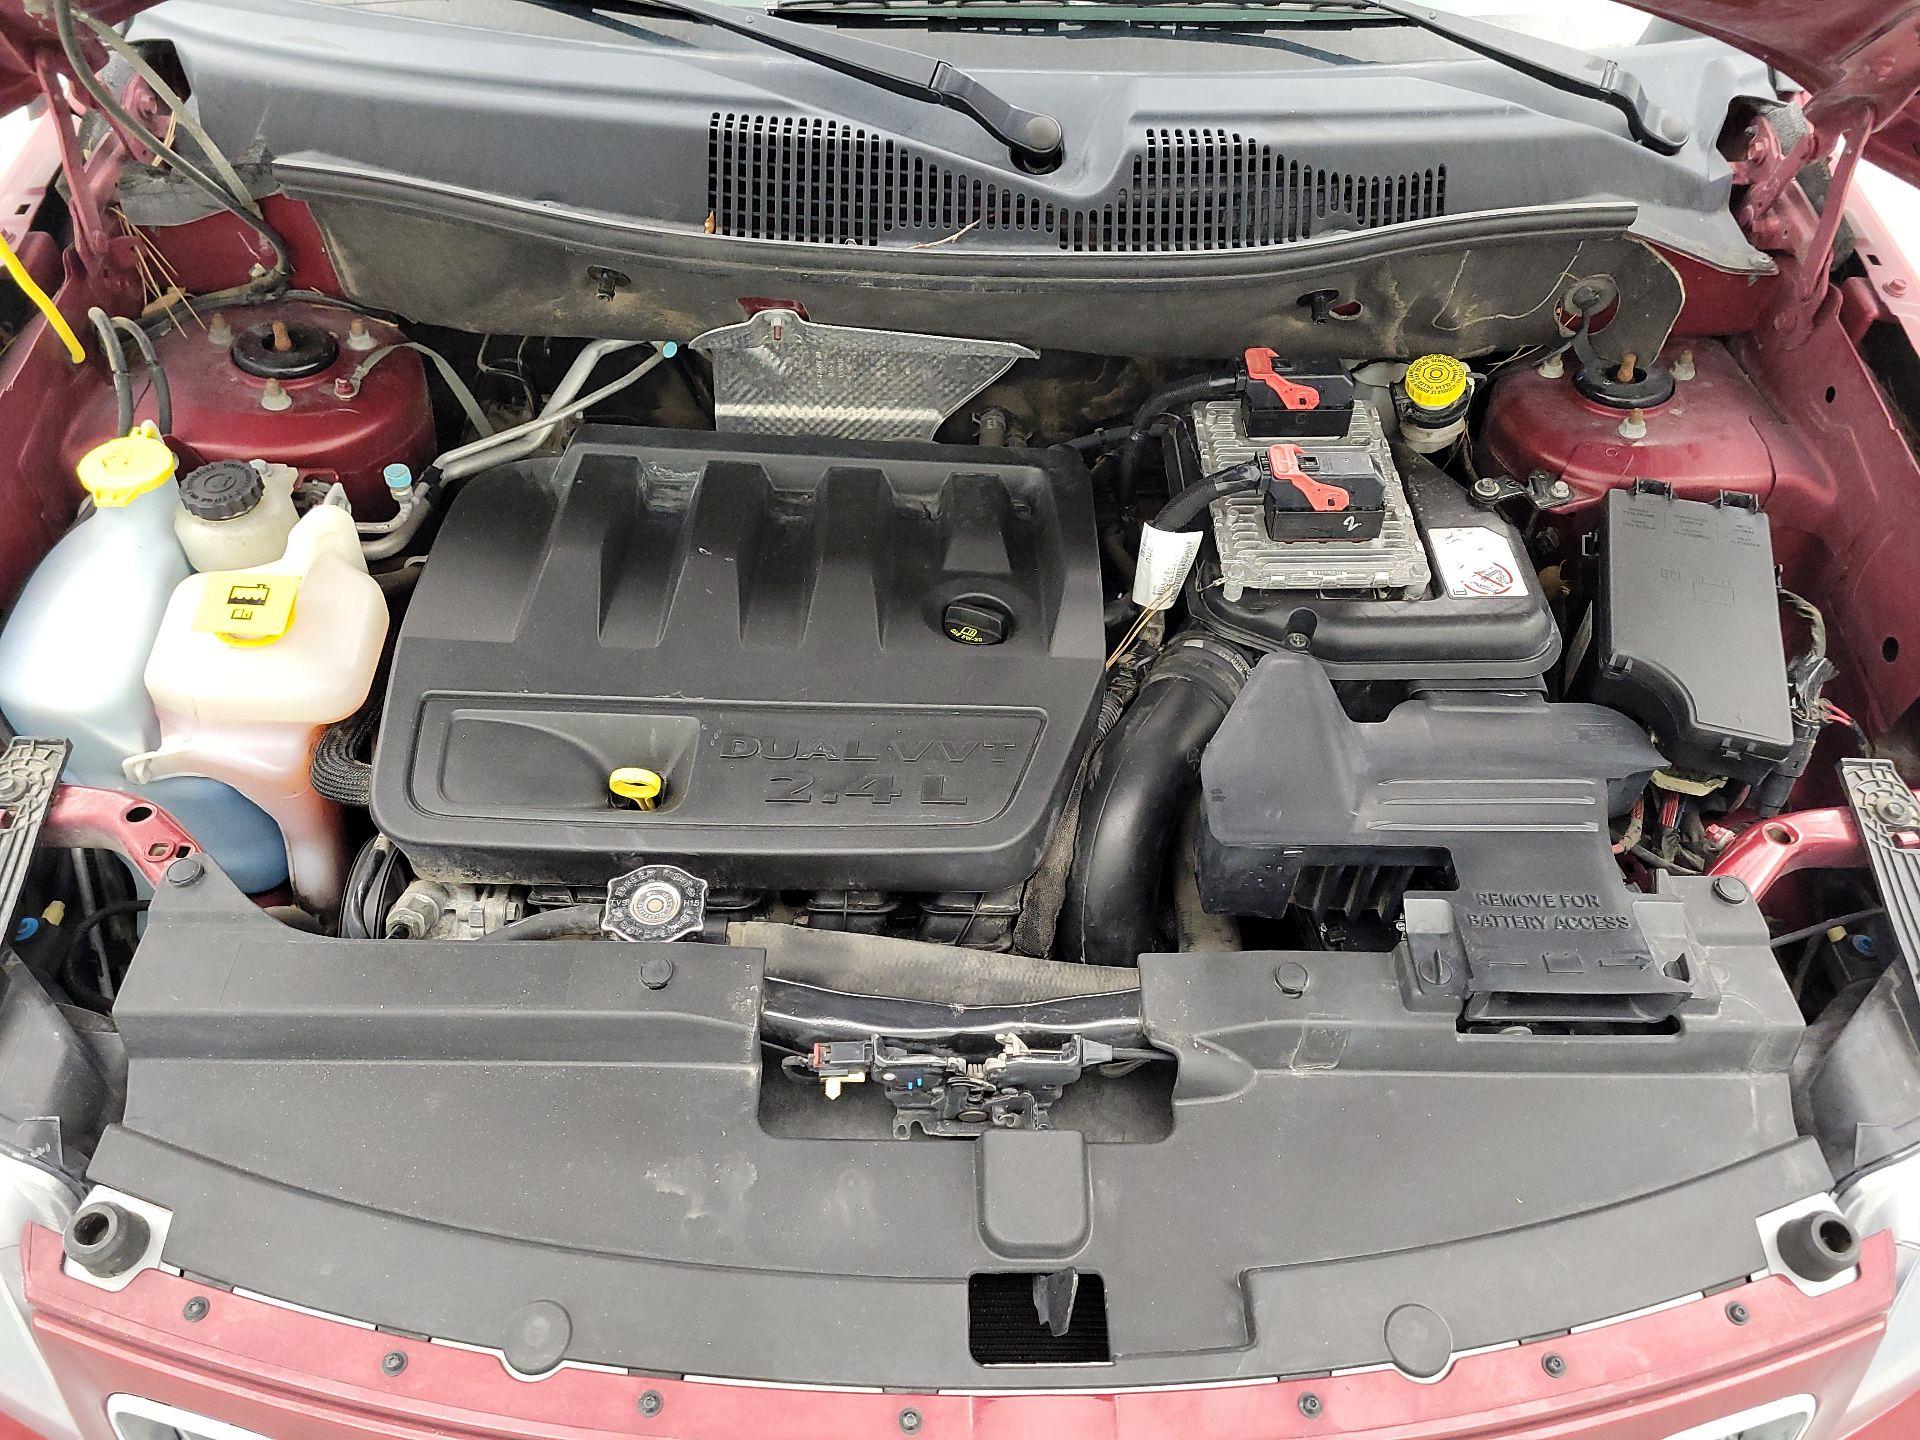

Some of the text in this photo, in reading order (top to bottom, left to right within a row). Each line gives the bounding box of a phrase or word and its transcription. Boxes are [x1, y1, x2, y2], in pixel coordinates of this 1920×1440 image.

[1343, 516, 1362, 531] 2
[719, 738, 1016, 763] DUAL VVT
[683, 899, 700, 907] H15
[1475, 892, 1601, 908] REMOVE FOR
[1467, 913, 1631, 930] BATTERY ACCESS
